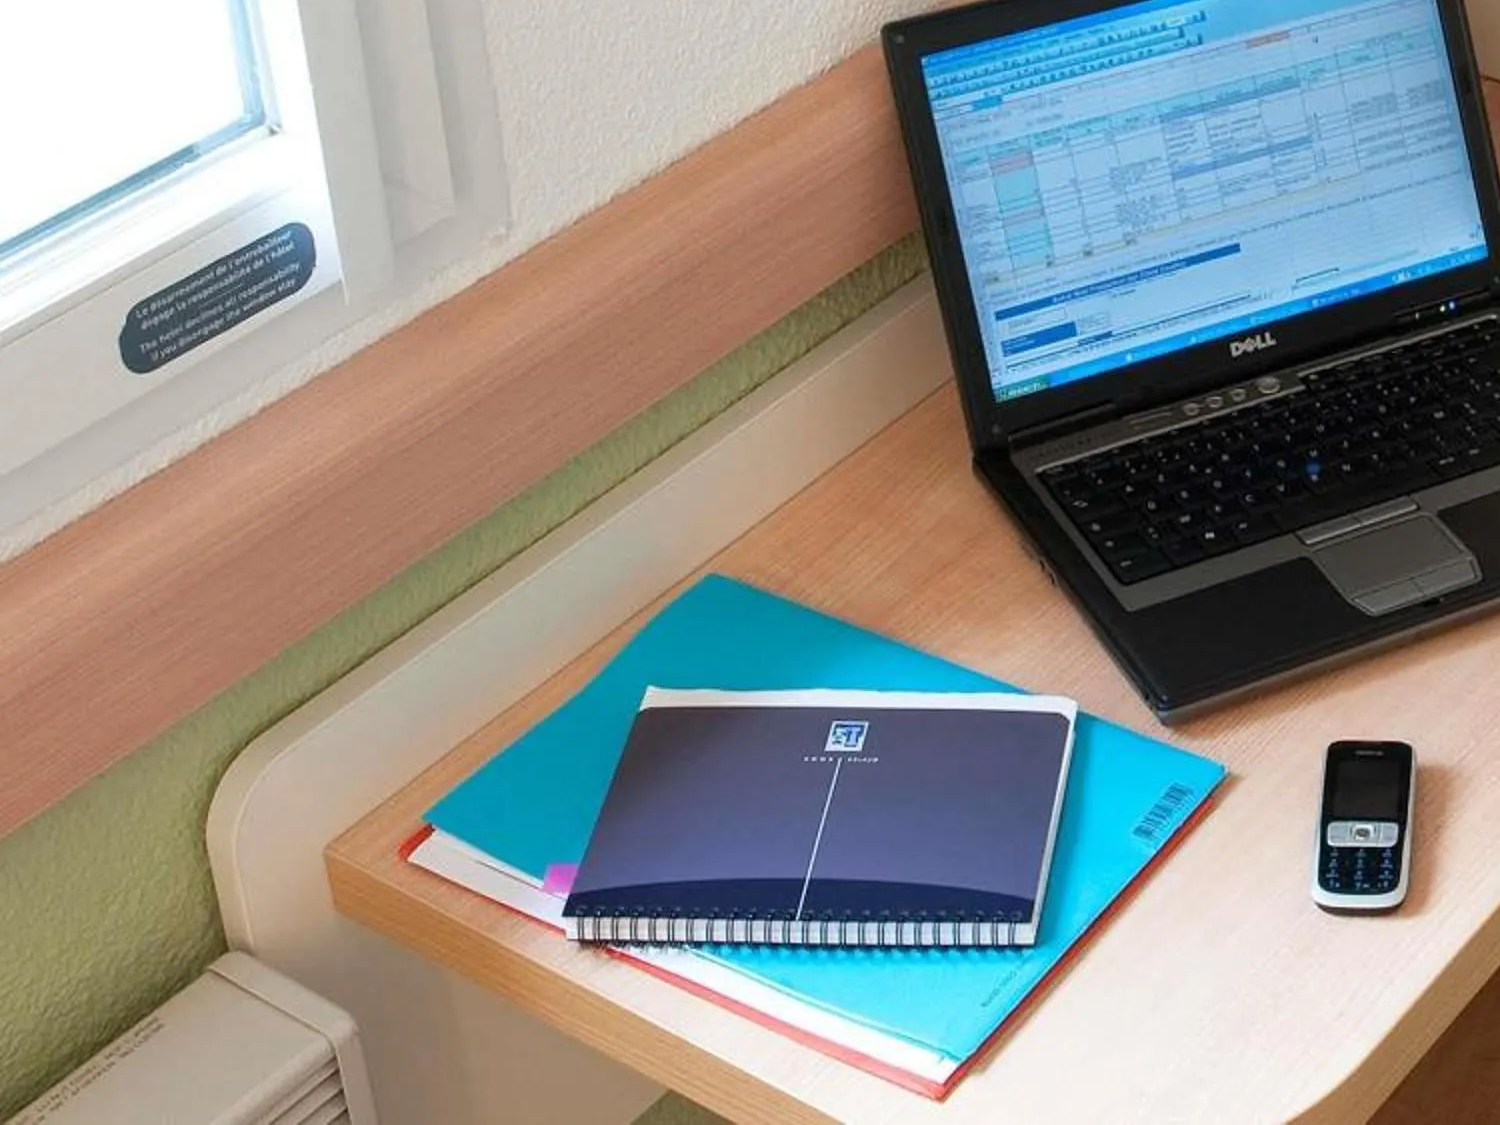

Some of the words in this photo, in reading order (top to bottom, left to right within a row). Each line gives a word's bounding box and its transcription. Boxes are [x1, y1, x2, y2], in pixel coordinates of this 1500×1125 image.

[141, 338, 158, 353] The
[160, 344, 176, 359] you
[1229, 331, 1277, 358] DELL
